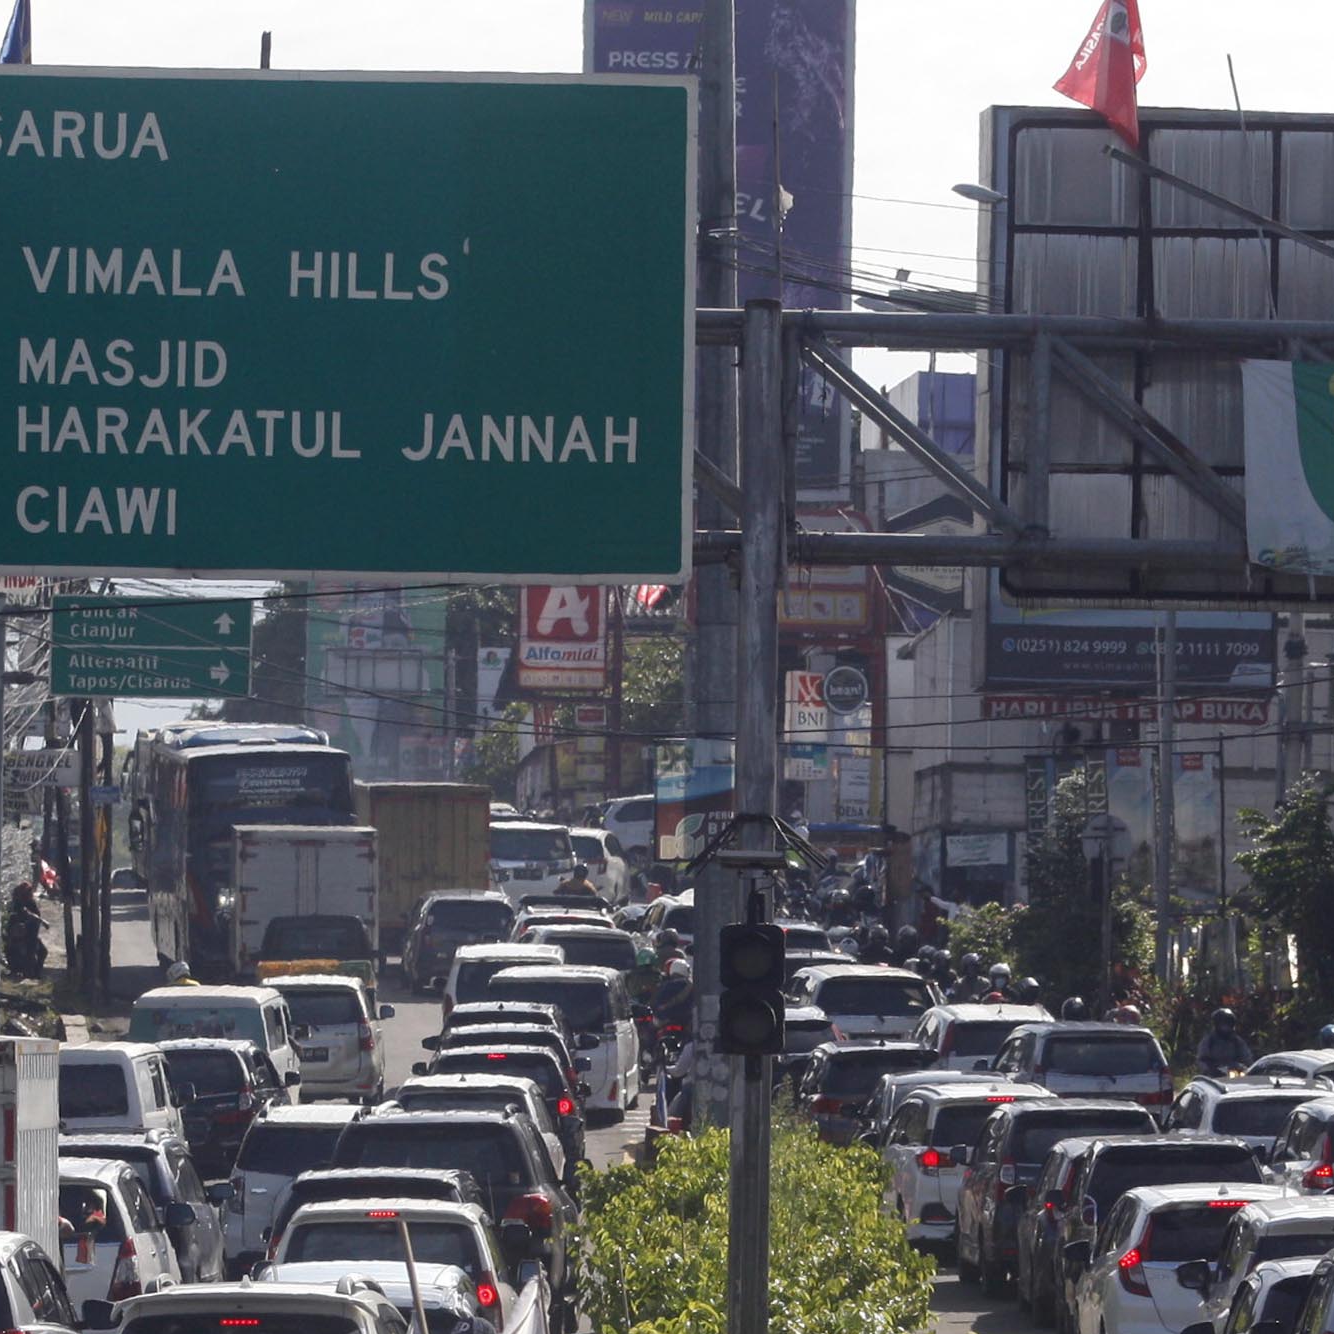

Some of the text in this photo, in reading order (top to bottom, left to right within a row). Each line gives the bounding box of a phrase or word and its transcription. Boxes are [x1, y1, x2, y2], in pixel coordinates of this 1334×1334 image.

[608, 51, 679, 70] PRESS
[23, 247, 448, 300] VIMALA HILLS
[19, 338, 227, 387] MASJID
[18, 406, 637, 463] HARAKATUL JANNAH
[17, 486, 176, 535] CIAWI
[69, 604, 138, 618] Puncak
[70, 623, 136, 640] Cianjur
[1064, 639, 1089, 652] 824
[1093, 639, 1127, 653] 9999
[1226, 643, 1259, 657] 7099
[69, 653, 160, 670] Alternatif
[798, 712, 825, 727] BNI
[991, 701, 1264, 721] HARI LIBUR TEAP BUKA
